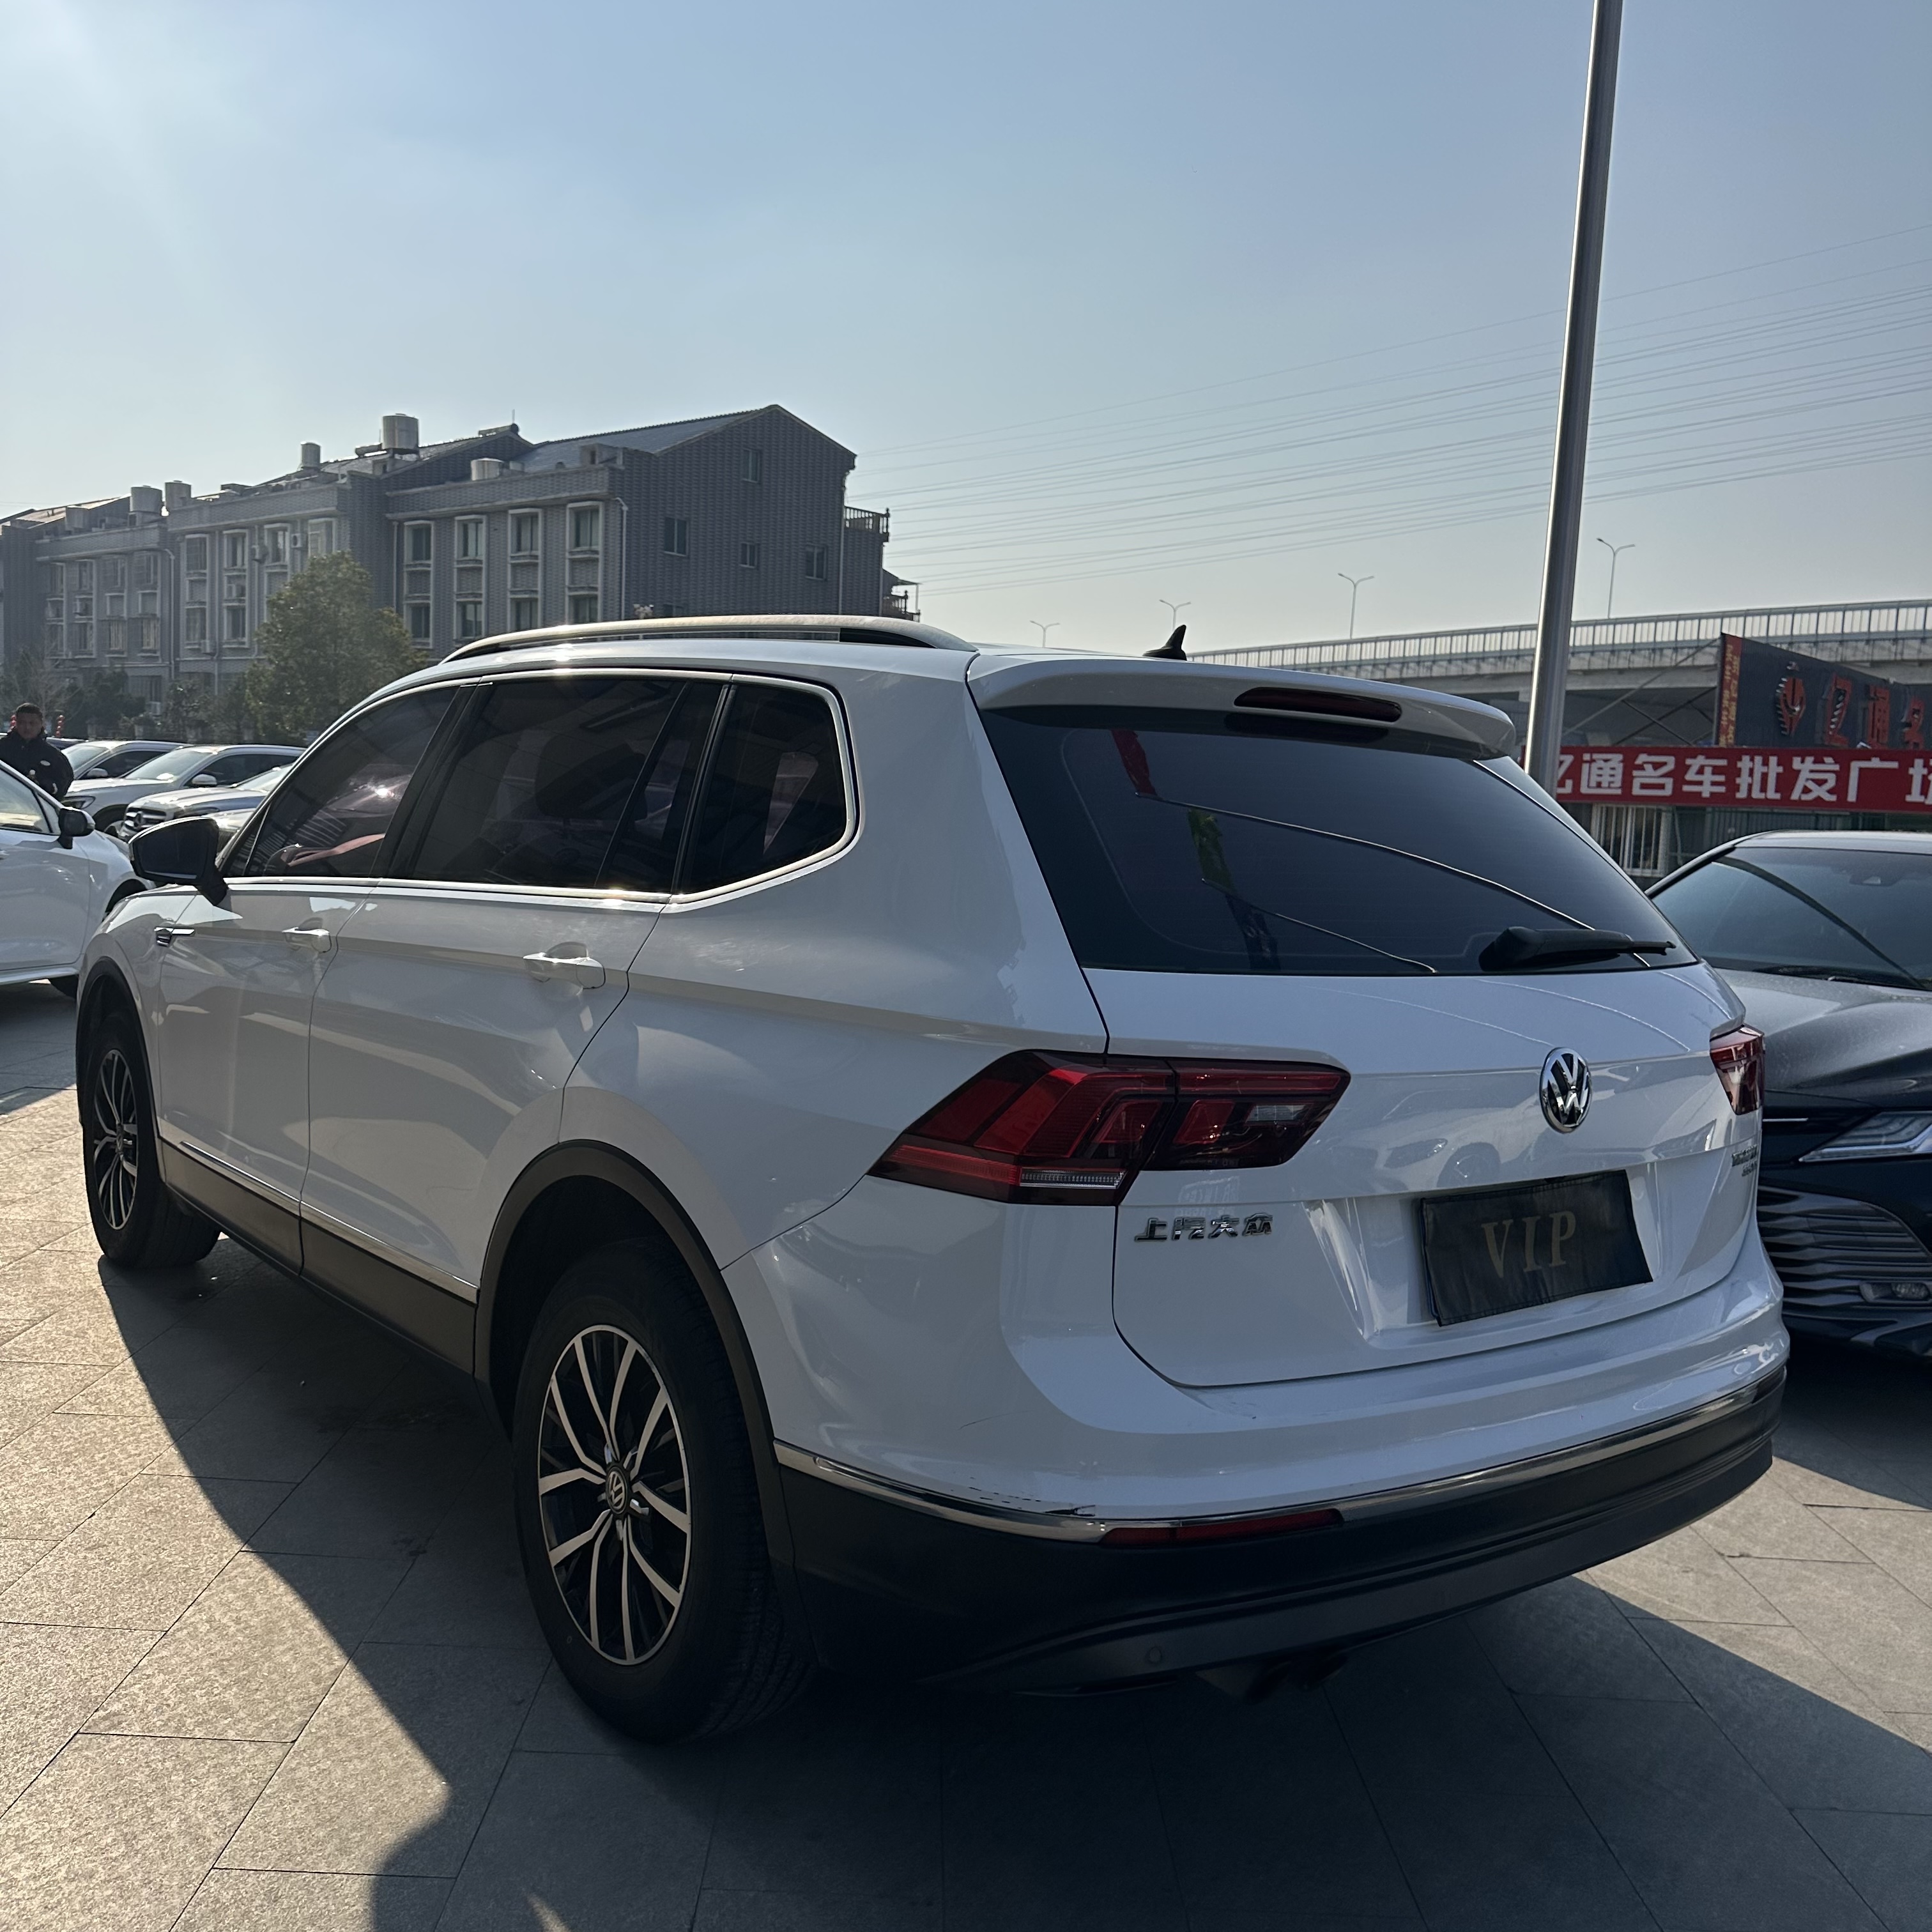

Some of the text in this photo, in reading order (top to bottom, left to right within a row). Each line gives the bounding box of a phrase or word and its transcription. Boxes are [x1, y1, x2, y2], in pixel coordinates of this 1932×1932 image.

[1135, 1213, 1273, 1242] 上汽大众
[1480, 1210, 1576, 1278] VIP
